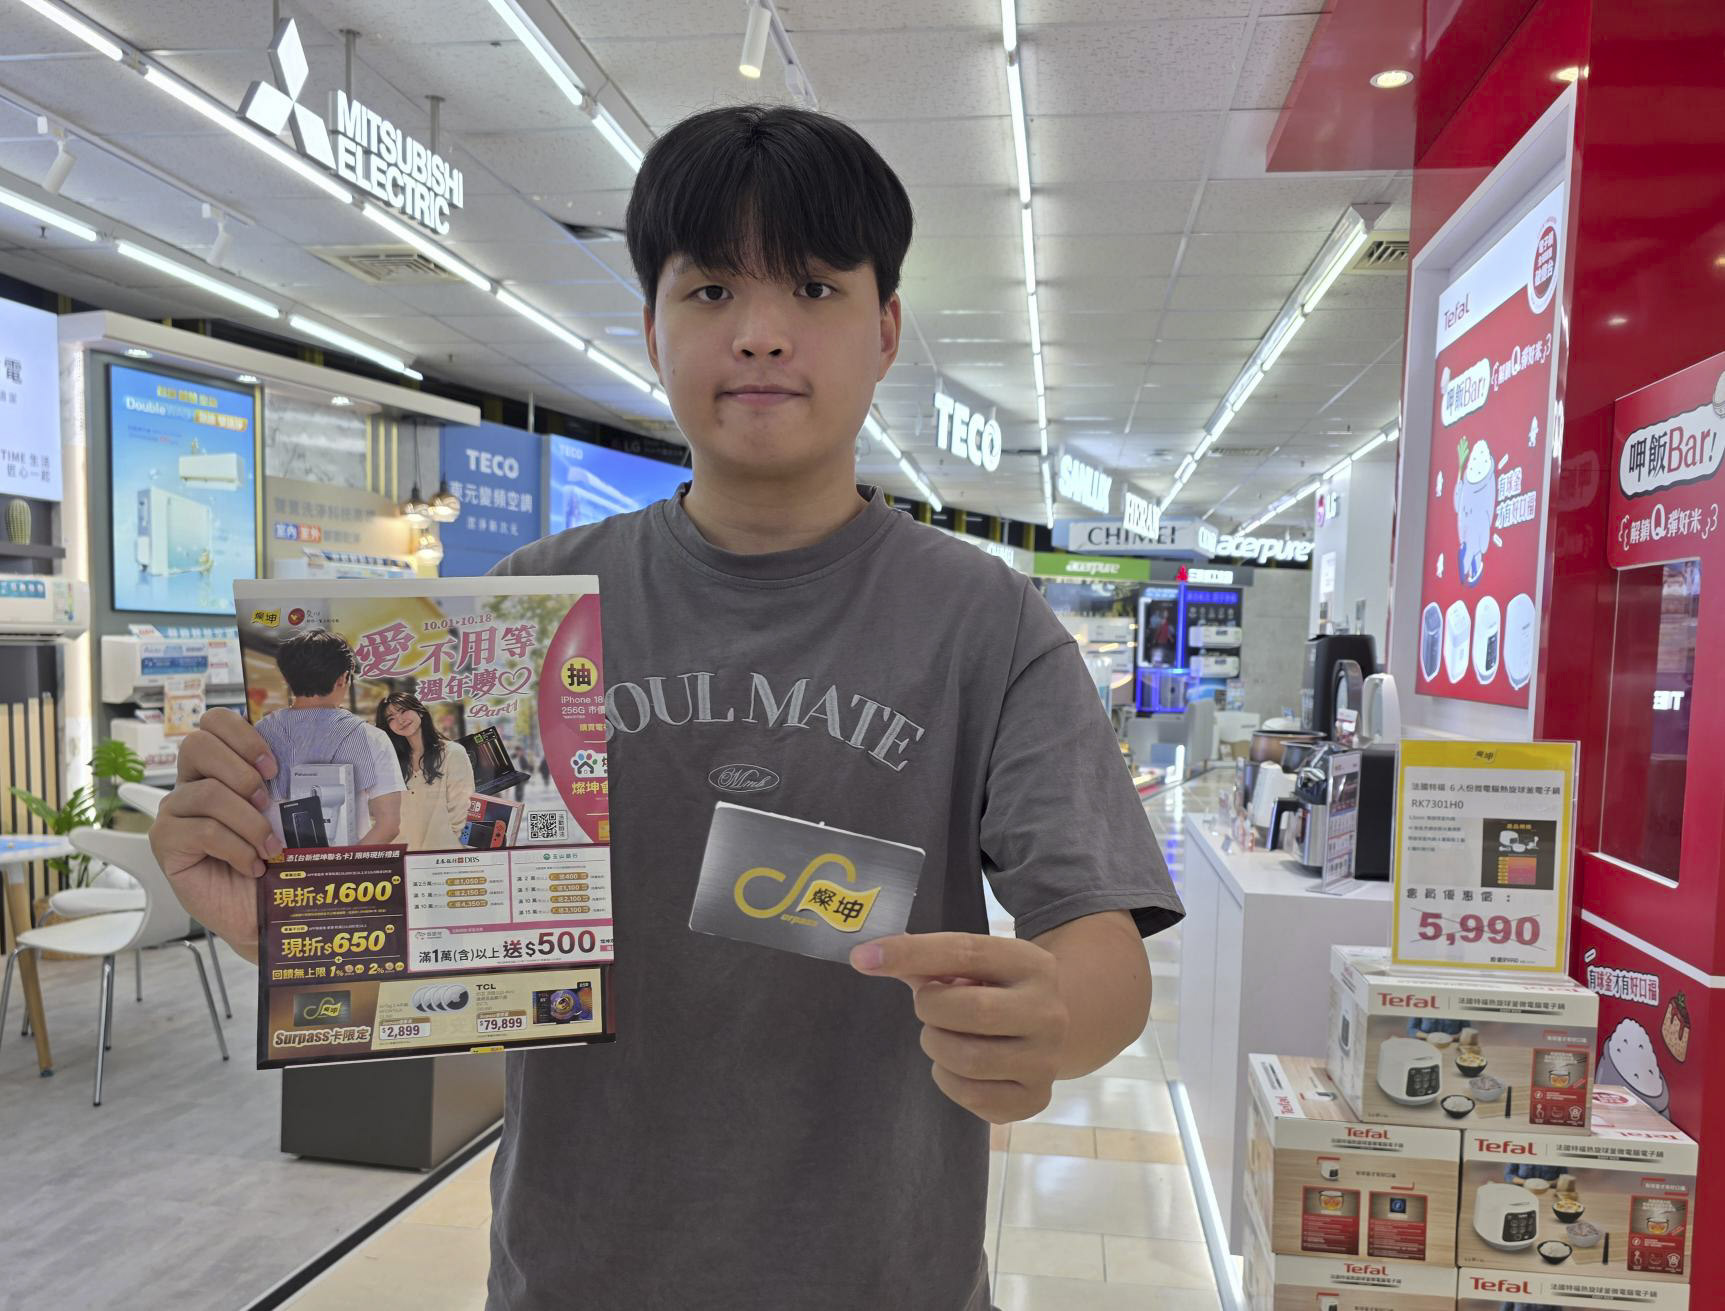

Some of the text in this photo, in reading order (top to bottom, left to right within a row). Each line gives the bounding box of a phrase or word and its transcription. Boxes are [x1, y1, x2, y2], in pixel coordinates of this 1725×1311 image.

[335, 89, 464, 208] MITSUBISHI
[335, 142, 450, 235] ELECTRIC
[1443, 293, 1470, 331] Tefal
[126, 395, 167, 416] Double
[934, 391, 1002, 472] TECO
[466, 448, 519, 479] TECO
[1628, 424, 1717, 483] 呷飯Bar!
[1629, 503, 1702, 545] 解鎖Q彈好米
[1216, 534, 1316, 564] acerpure
[423, 613, 492, 632] 10.01 10.18
[355, 622, 537, 680] 愛不用等
[416, 668, 498, 703] 週年慶
[567, 663, 592, 687] 抽
[605, 671, 925, 772] OUL MATE
[1449, 785, 1455, 793] 6
[1411, 799, 1464, 810] RK7301H0
[464, 855, 480, 864] DBS
[274, 880, 393, 907] 現折$1,600
[808, 887, 864, 923] 燦坤
[1417, 911, 1541, 946] 5,990
[281, 930, 386, 957] 現折$650
[419, 929, 597, 964] 滿1萬(含)以上 送$500
[476, 983, 497, 991] TCL
[1588, 967, 1659, 1003] 有球釜才有好口福
[1377, 992, 1441, 1010] Tefal
[275, 1027, 371, 1047] Surpass卡限定
[382, 1025, 421, 1039] $2,899
[479, 1017, 523, 1031] $79,899
[1344, 1126, 1391, 1140] Tefal
[1474, 1138, 1537, 1156] Tefal
[1344, 1263, 1389, 1276] Tefal
[1469, 1276, 1532, 1295] Tefal
